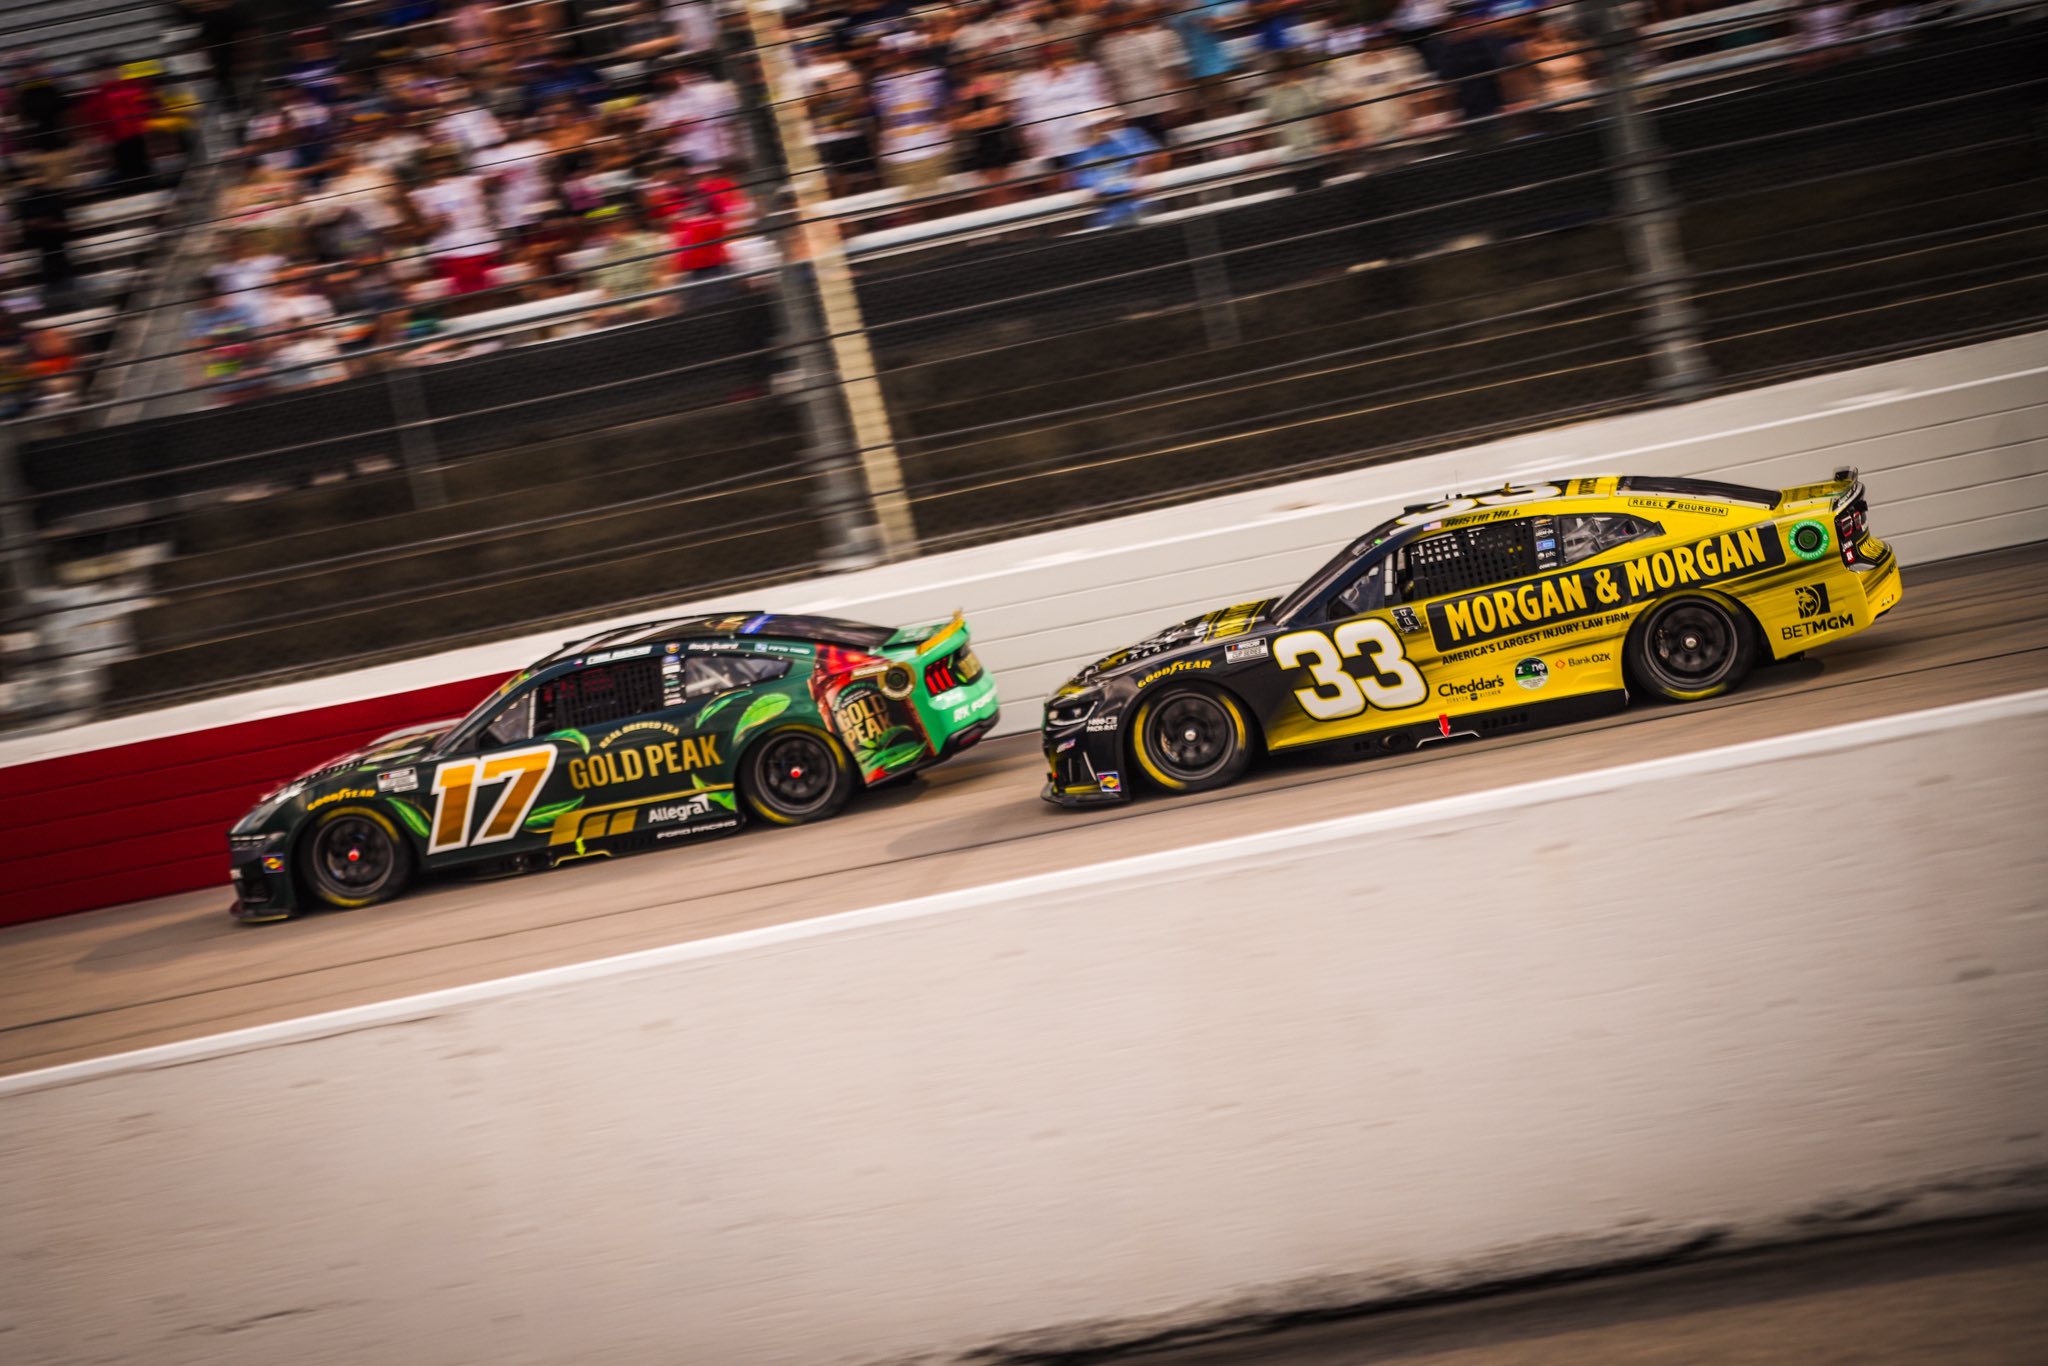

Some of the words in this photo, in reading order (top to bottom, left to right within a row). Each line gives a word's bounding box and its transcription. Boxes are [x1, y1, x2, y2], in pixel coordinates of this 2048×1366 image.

[1445, 513, 1490, 527] AUSTIN
[1492, 508, 1520, 519] HILL
[1632, 499, 1664, 508] REBEL
[1677, 502, 1725, 514] BOURBON
[1444, 574, 1588, 641] MORGAN
[1593, 568, 1621, 604] &
[1624, 527, 1766, 597] MORGAN
[1442, 643, 1496, 665] AMERICA'S
[1497, 633, 1541, 651] LARGEST
[1543, 624, 1581, 639] INJURY
[1582, 618, 1604, 629] LAW
[1606, 611, 1630, 624] FIRM
[1781, 613, 1855, 640] BETMGM
[1138, 660, 1212, 688] GOODYEAR
[1273, 617, 1430, 721] 33
[1568, 656, 1592, 667] Bank
[1592, 653, 1611, 663] OZK
[1438, 674, 1504, 698] Cheddar's
[835, 694, 888, 733] GOLD
[568, 748, 644, 790] GOLD
[644, 734, 723, 777] PEAK
[427, 743, 558, 855] 17
[648, 800, 706, 824] Allegra
